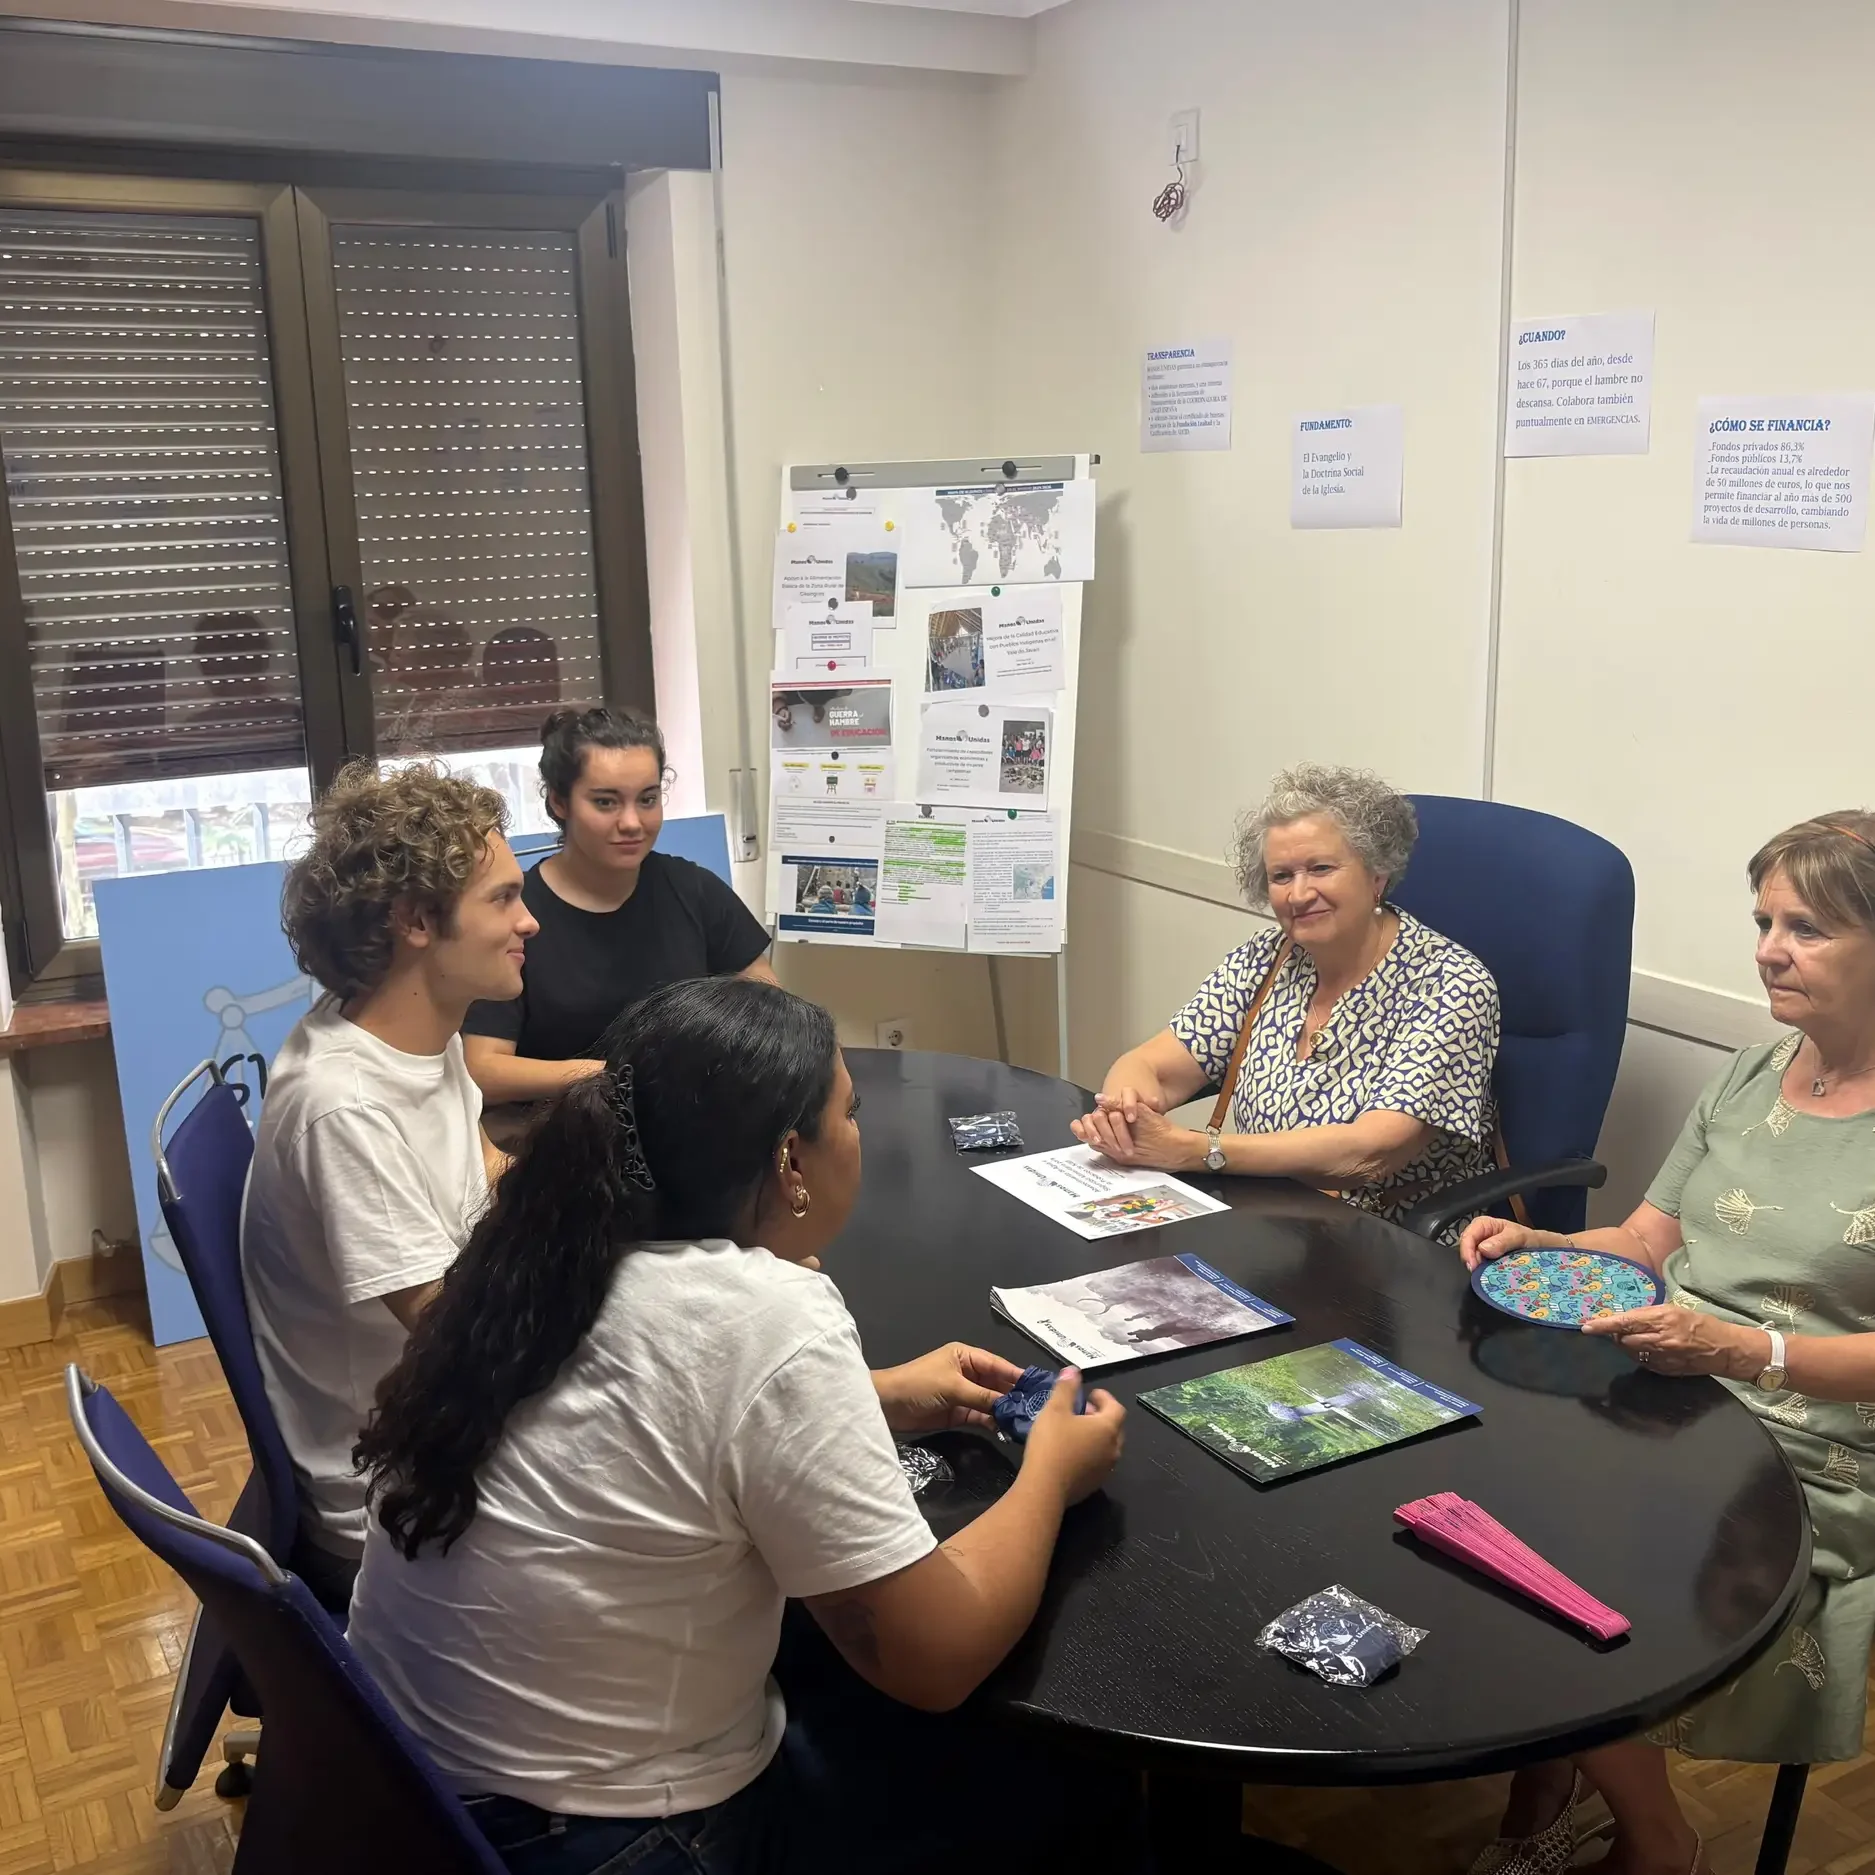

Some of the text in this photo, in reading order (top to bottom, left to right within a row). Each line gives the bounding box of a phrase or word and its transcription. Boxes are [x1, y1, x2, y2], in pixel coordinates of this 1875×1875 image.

[1519, 330, 1566, 345] ¿CUANDO?
[1147, 349, 1195, 360] TRANSPARENCIA
[1518, 361, 1531, 370] Los
[1533, 359, 1548, 369] 365
[1571, 356, 1584, 367] del
[1587, 355, 1605, 367] año,
[1607, 353, 1633, 364] desde
[1517, 374, 1643, 390] hace 67, porque el hambre no
[1516, 393, 1633, 408] descansa. Colabora también
[1300, 418, 1352, 431] FUNDAMENTO:
[1516, 415, 1640, 429] puntualmente en EMERGENCIAS.
[1710, 417, 1831, 433] ¿CÓMO SE FINANCIA?
[1743, 442, 1778, 452] privados
[1780, 442, 1804, 451] 86,3%
[1303, 452, 1352, 463] El Evangelio y
[1742, 454, 1776, 464] públicos
[1779, 455, 1802, 463] 13,7%
[1303, 466, 1364, 479] la Doctrina Social
[1721, 465, 1769, 475] recaudación
[1772, 466, 1794, 476] anual
[1807, 467, 1850, 476] alrededor
[1302, 484, 1345, 496] de la Iglesia.
[1705, 478, 1850, 491] de 50 millones de euros, lo que nos
[1704, 491, 1852, 503] permite financiar al año más de 500
[1704, 504, 1849, 517] proyectos de desarrollo, cambiando
[1703, 515, 1831, 530] la vida de millones de personas.
[829, 710, 858, 718] GUERRA
[829, 718, 860, 726] HAMBRE
[1044, 1323, 1067, 1340] Unidas
[1075, 1344, 1098, 1360] Manos
[1249, 1450, 1280, 1469] Manos
